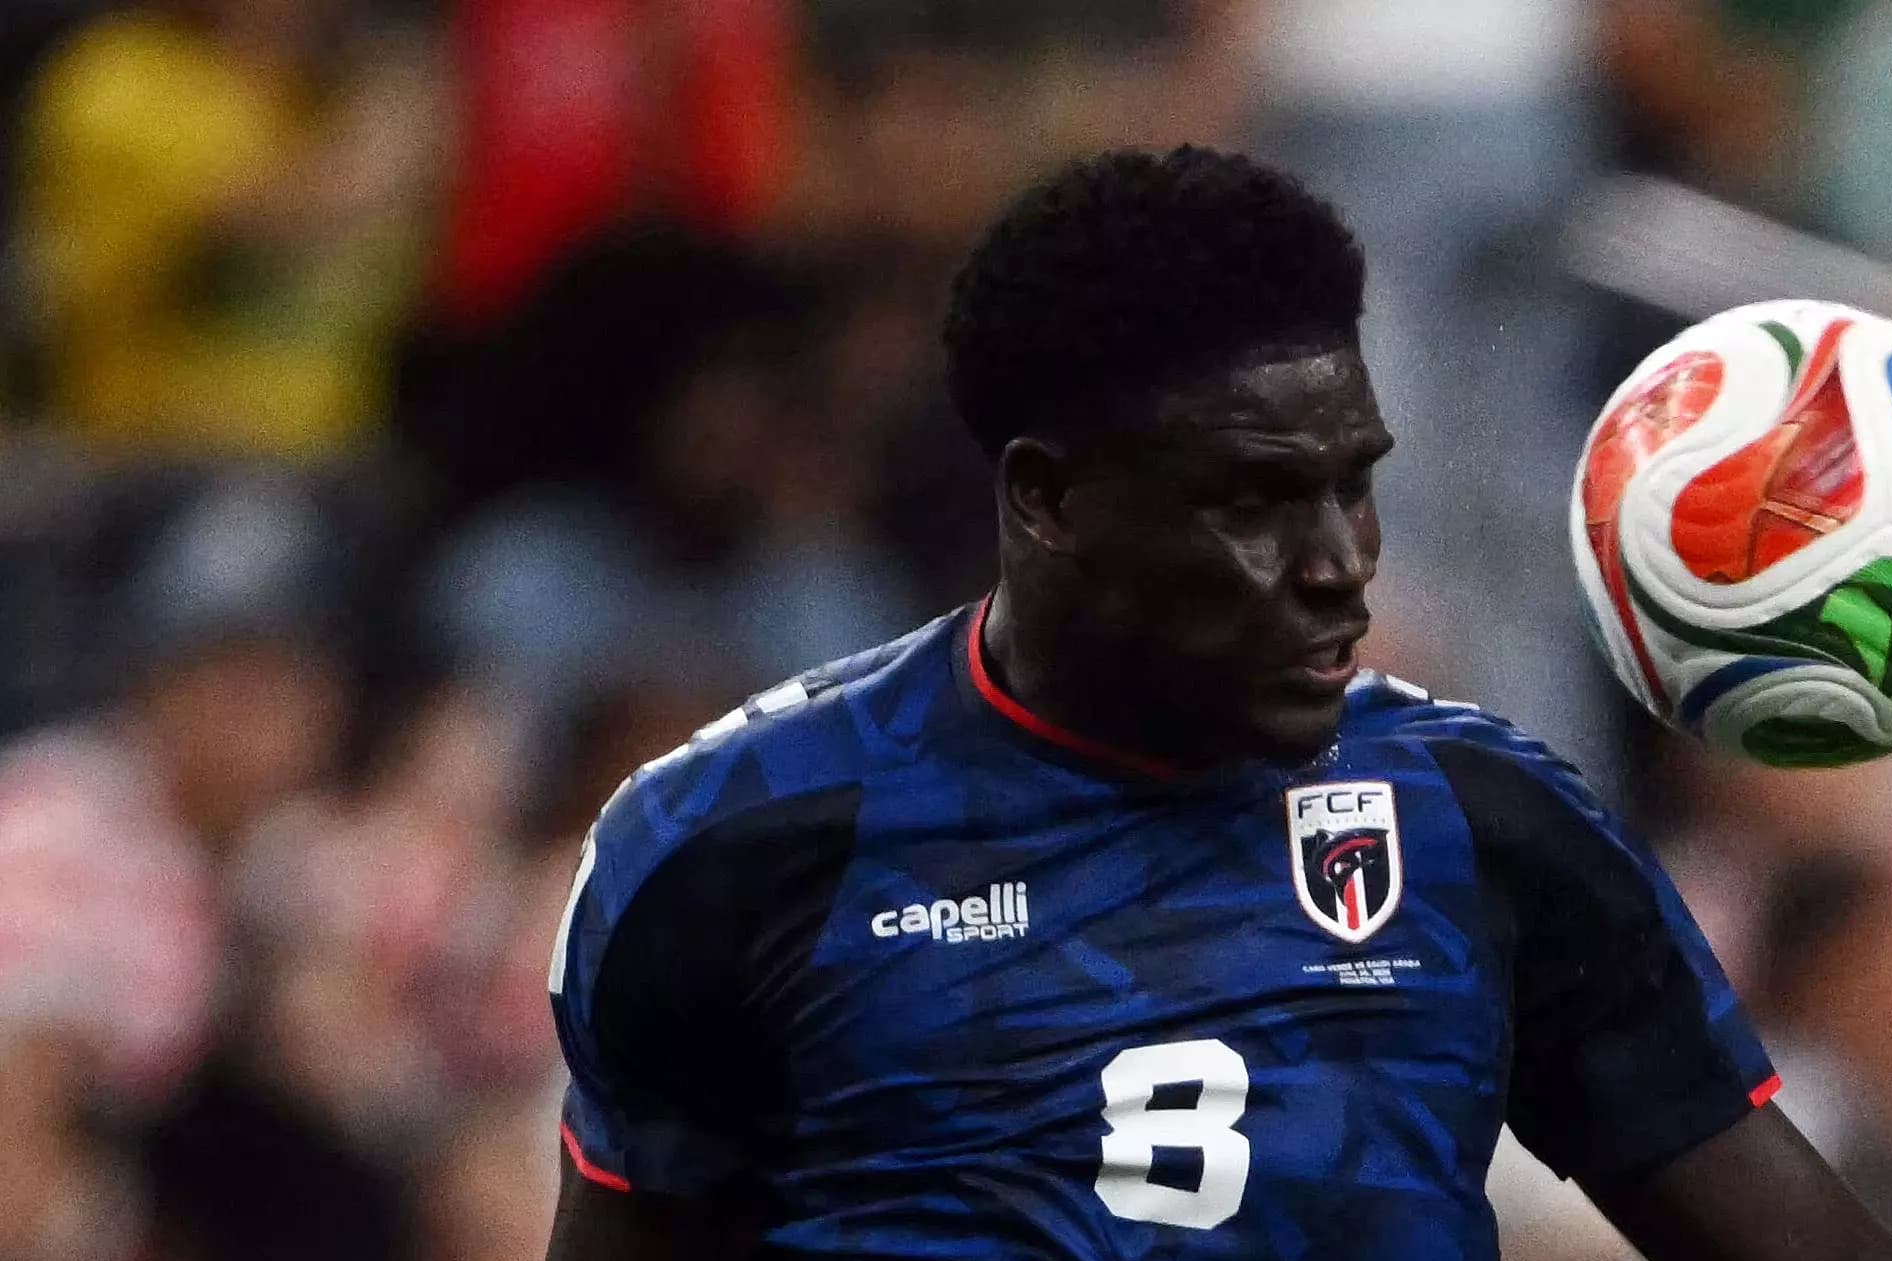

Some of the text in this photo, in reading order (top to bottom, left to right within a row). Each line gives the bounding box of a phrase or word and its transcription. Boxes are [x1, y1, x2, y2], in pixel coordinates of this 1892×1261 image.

[1297, 791, 1383, 819] FCF
[871, 881, 1028, 940] capelli
[946, 923, 1029, 943] SPORT
[1095, 1039, 1250, 1230] 8
